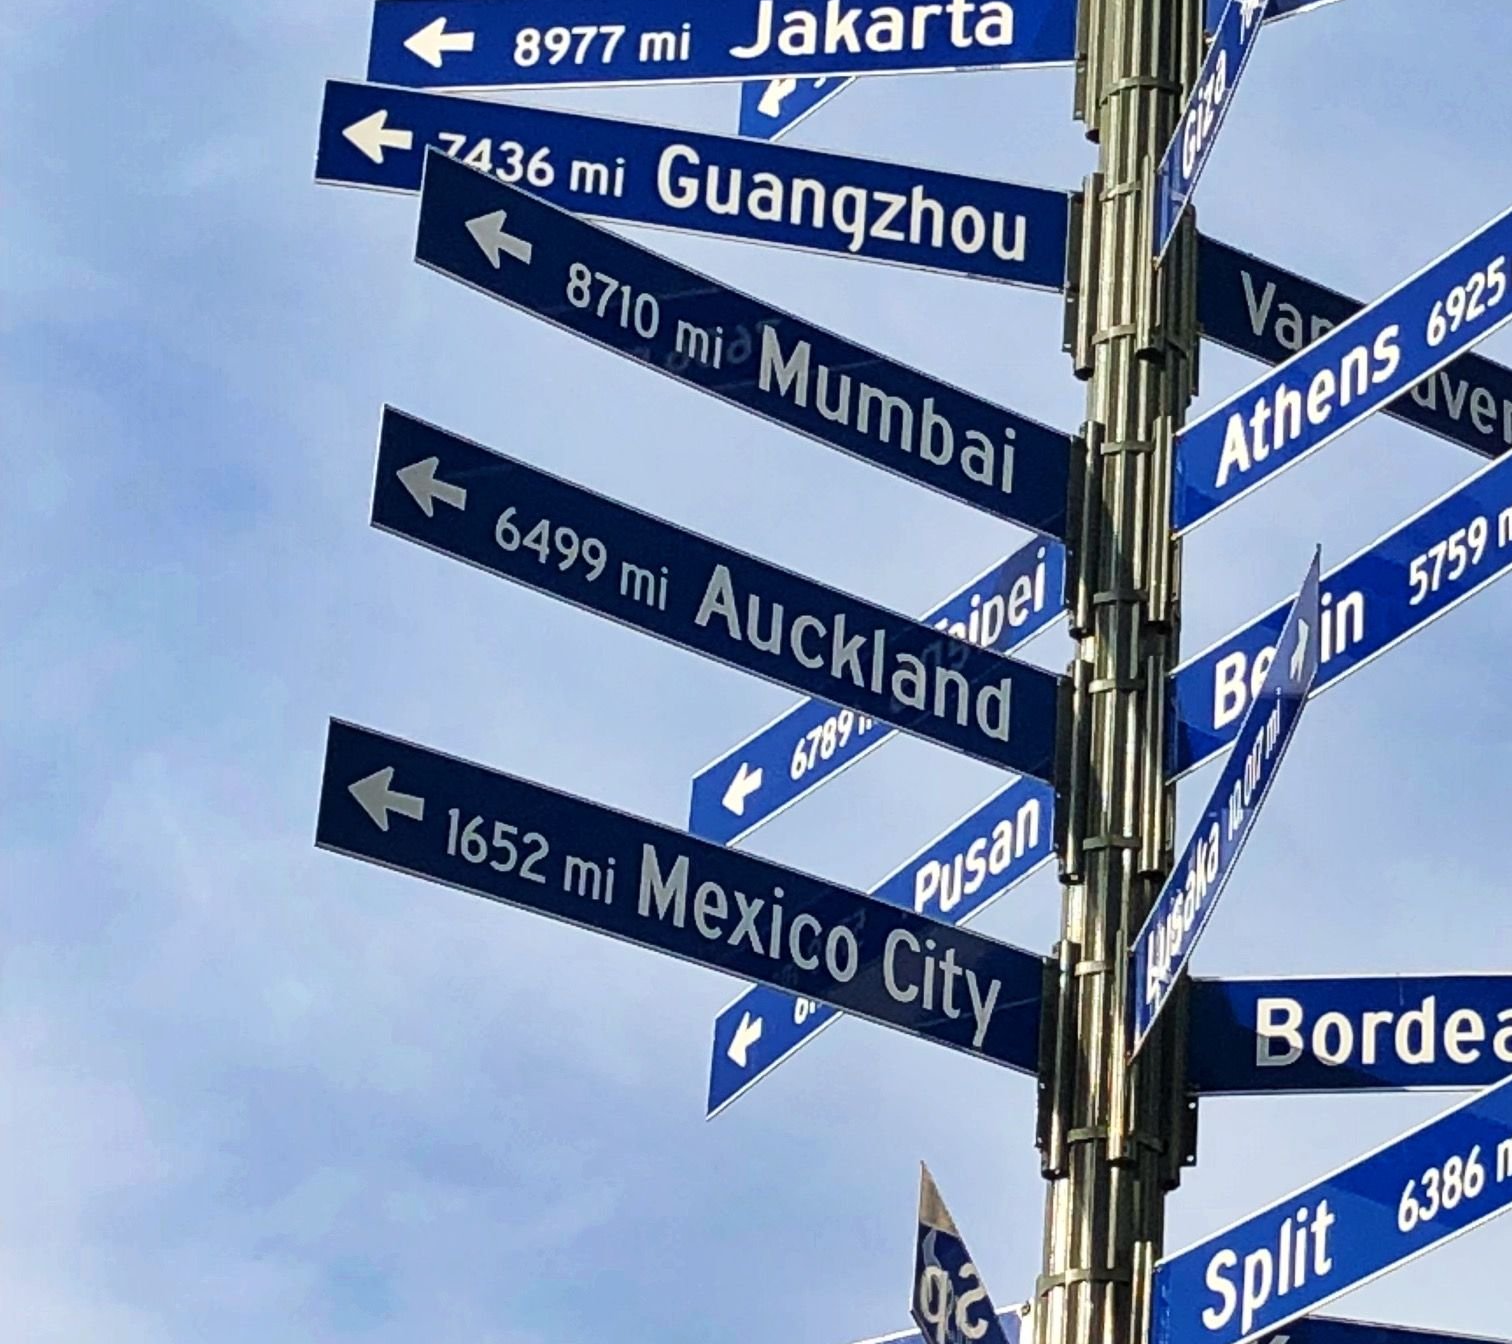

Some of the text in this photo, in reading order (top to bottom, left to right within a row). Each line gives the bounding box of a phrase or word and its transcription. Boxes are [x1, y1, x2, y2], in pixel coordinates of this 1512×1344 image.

[514, 24, 625, 67] 8977
[640, 22, 691, 62] mi
[1182, 48, 1227, 180] Giza
[569, 157, 625, 198] mi
[657, 143, 1027, 261] Guangzhou
[565, 262, 1017, 494] 8710 mi Mumbai
[1215, 324, 1400, 489] Athens
[1426, 255, 1507, 347] 6925
[494, 506, 1013, 742] 6499 mi Auckland
[1213, 590, 1364, 730] Bein
[1408, 516, 1487, 606] 5759
[790, 710, 853, 780] 6789
[446, 808, 1002, 1048] 1652 mi Mexico City
[914, 798, 1040, 913] Pusan
[1201, 1199, 1335, 1336] Split
[1397, 1144, 1485, 1233] 6386
